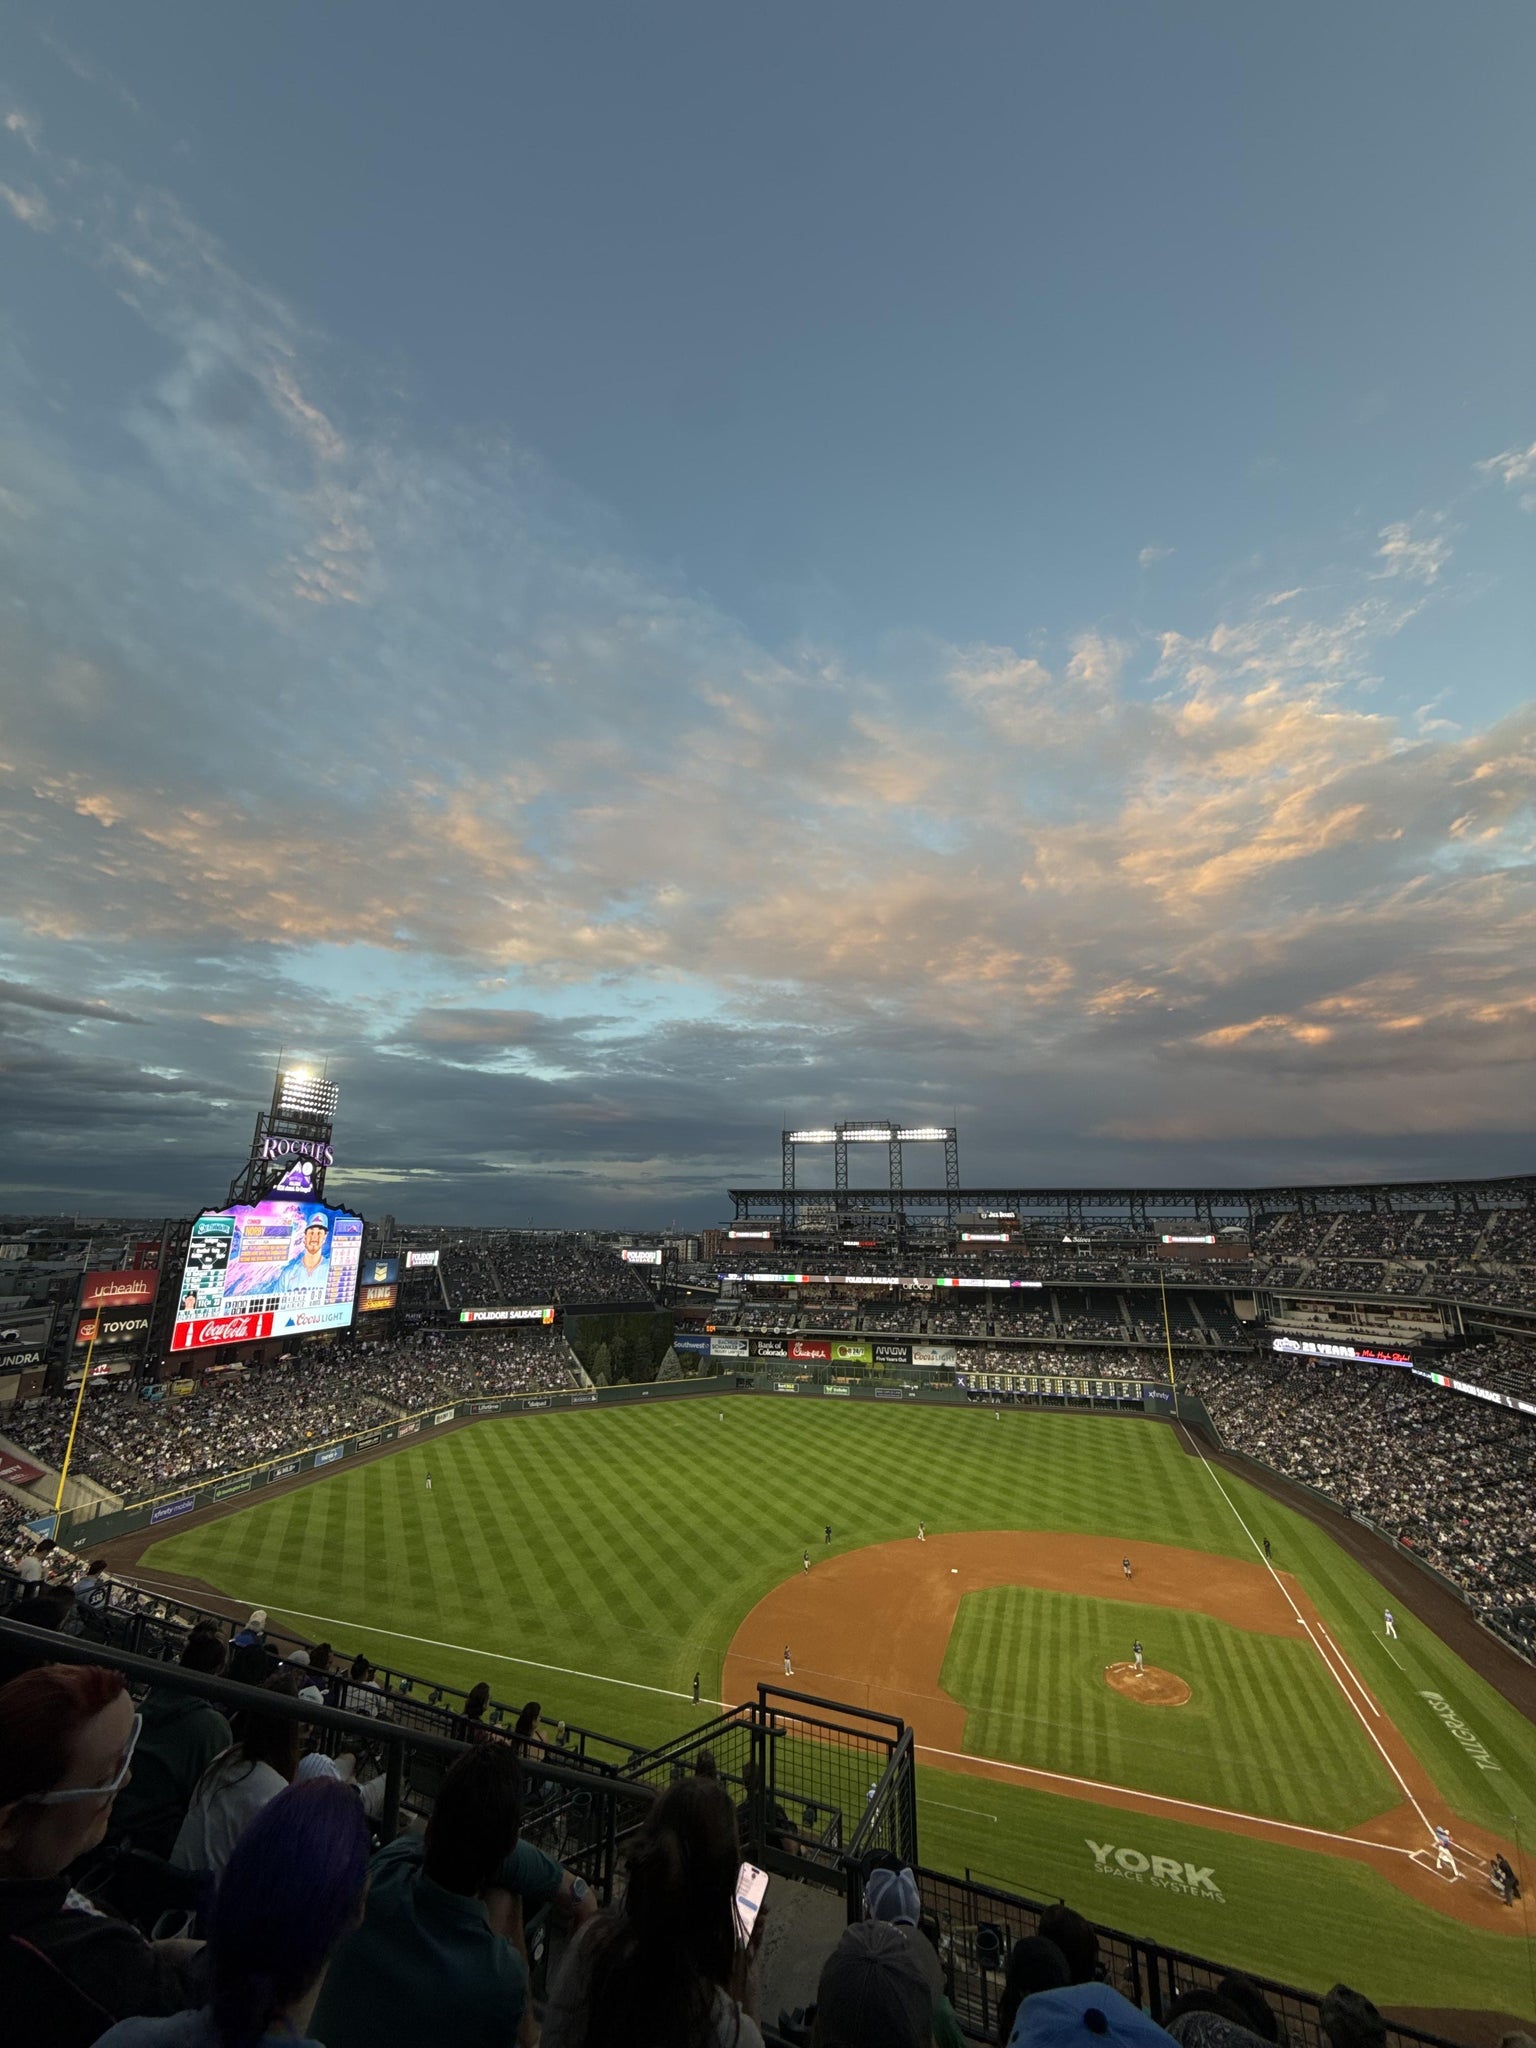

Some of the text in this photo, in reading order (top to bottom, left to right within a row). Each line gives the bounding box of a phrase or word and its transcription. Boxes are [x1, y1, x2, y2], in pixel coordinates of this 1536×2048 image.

[260, 1136, 334, 1167] ROCKIES
[94, 1279, 147, 1297] uchealth
[366, 1286, 391, 1299] KING
[296, 1312, 343, 1326] Coors LIGHT
[473, 1310, 542, 1321] POLIDORI SAUSAGE
[103, 1319, 148, 1333] TOYOTA
[199, 1317, 251, 1342] Coca-Cola
[673, 1341, 705, 1349] Southwest
[757, 1341, 773, 1349] Bank
[876, 1347, 907, 1355] ARROW
[1317, 1343, 1355, 1357] YEARS
[757, 1348, 787, 1357] Colorado
[935, 1353, 956, 1362] LIGHT
[1148, 1390, 1169, 1400] xfinity
[478, 1403, 499, 1411] Lifetime
[154, 1501, 193, 1519] xfinity mobile
[1428, 1700, 1501, 1771] TALLGRASS
[1084, 1839, 1222, 1892] YORK
[1094, 1862, 1226, 1904] SPACE SYSTEMS
